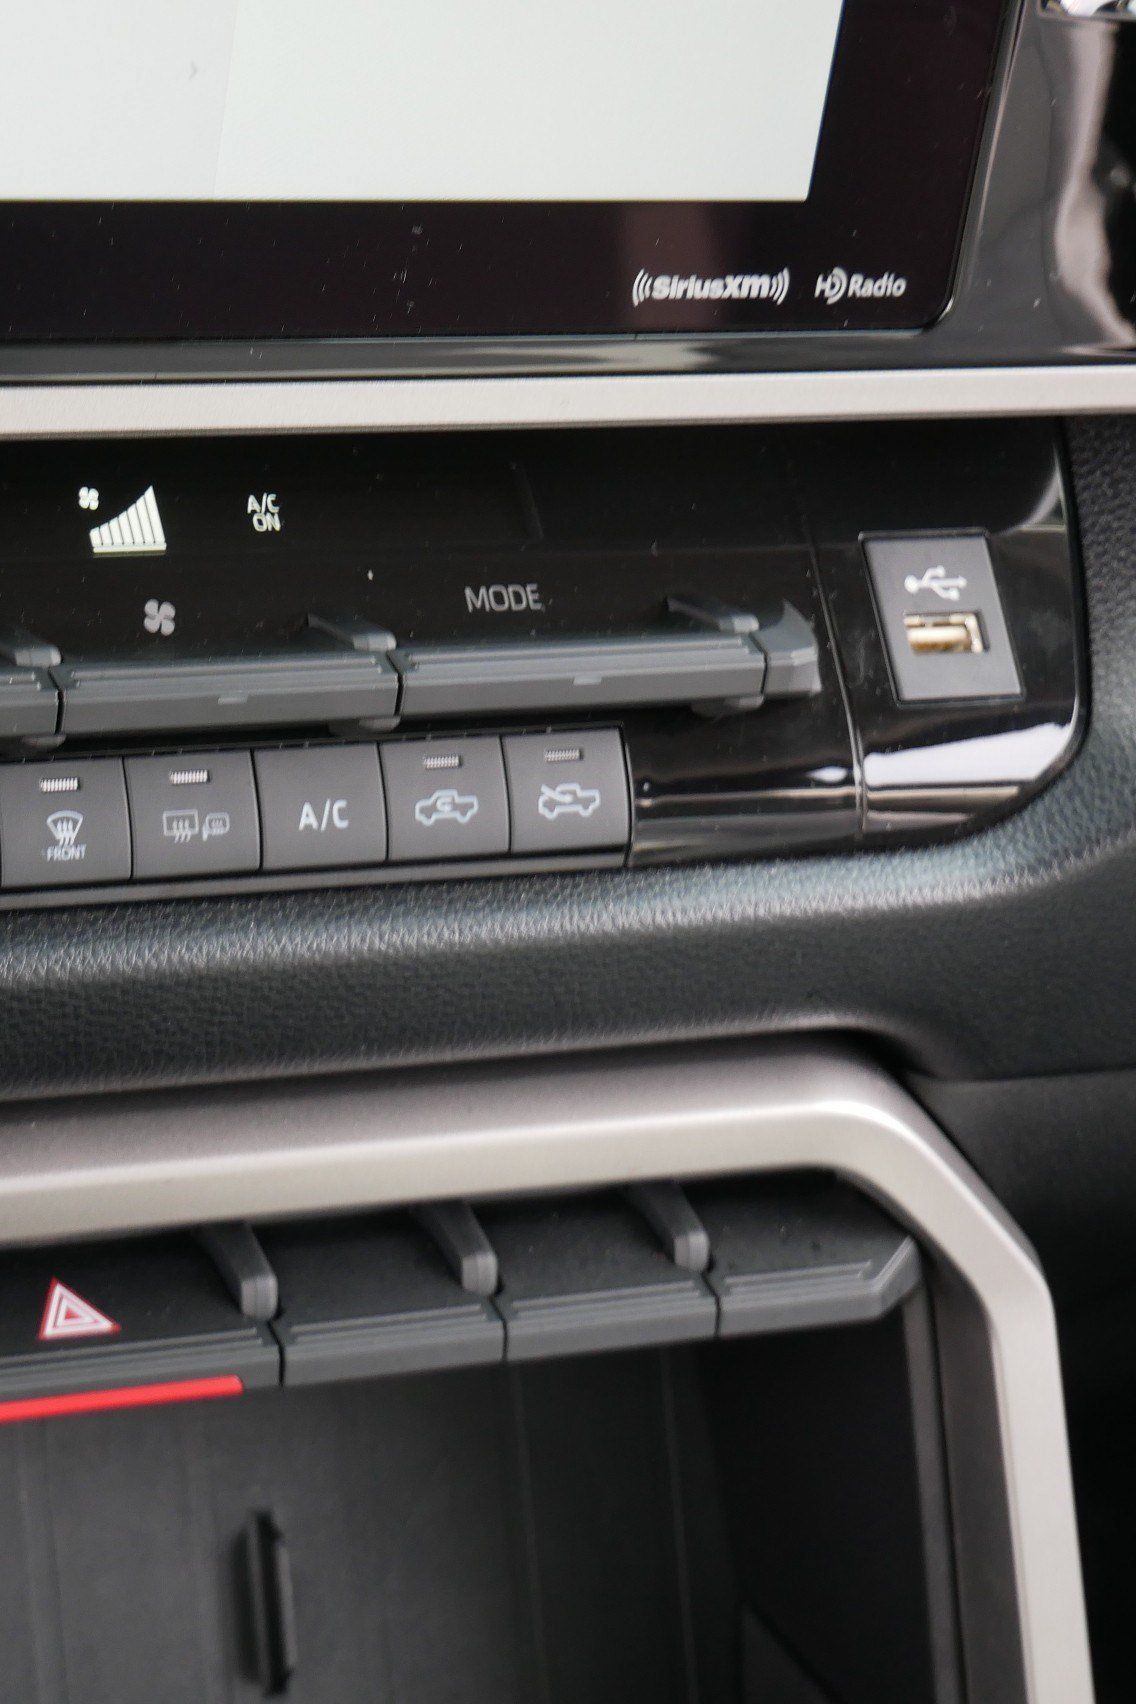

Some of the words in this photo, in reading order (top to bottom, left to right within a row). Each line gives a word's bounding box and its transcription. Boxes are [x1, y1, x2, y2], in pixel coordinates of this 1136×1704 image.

[848, 273, 907, 298] Radio
[247, 492, 280, 514] A/C
[253, 512, 281, 532] ON
[464, 583, 543, 613] MODE
[298, 798, 349, 832] A/C
[46, 843, 87, 861] FRONT
